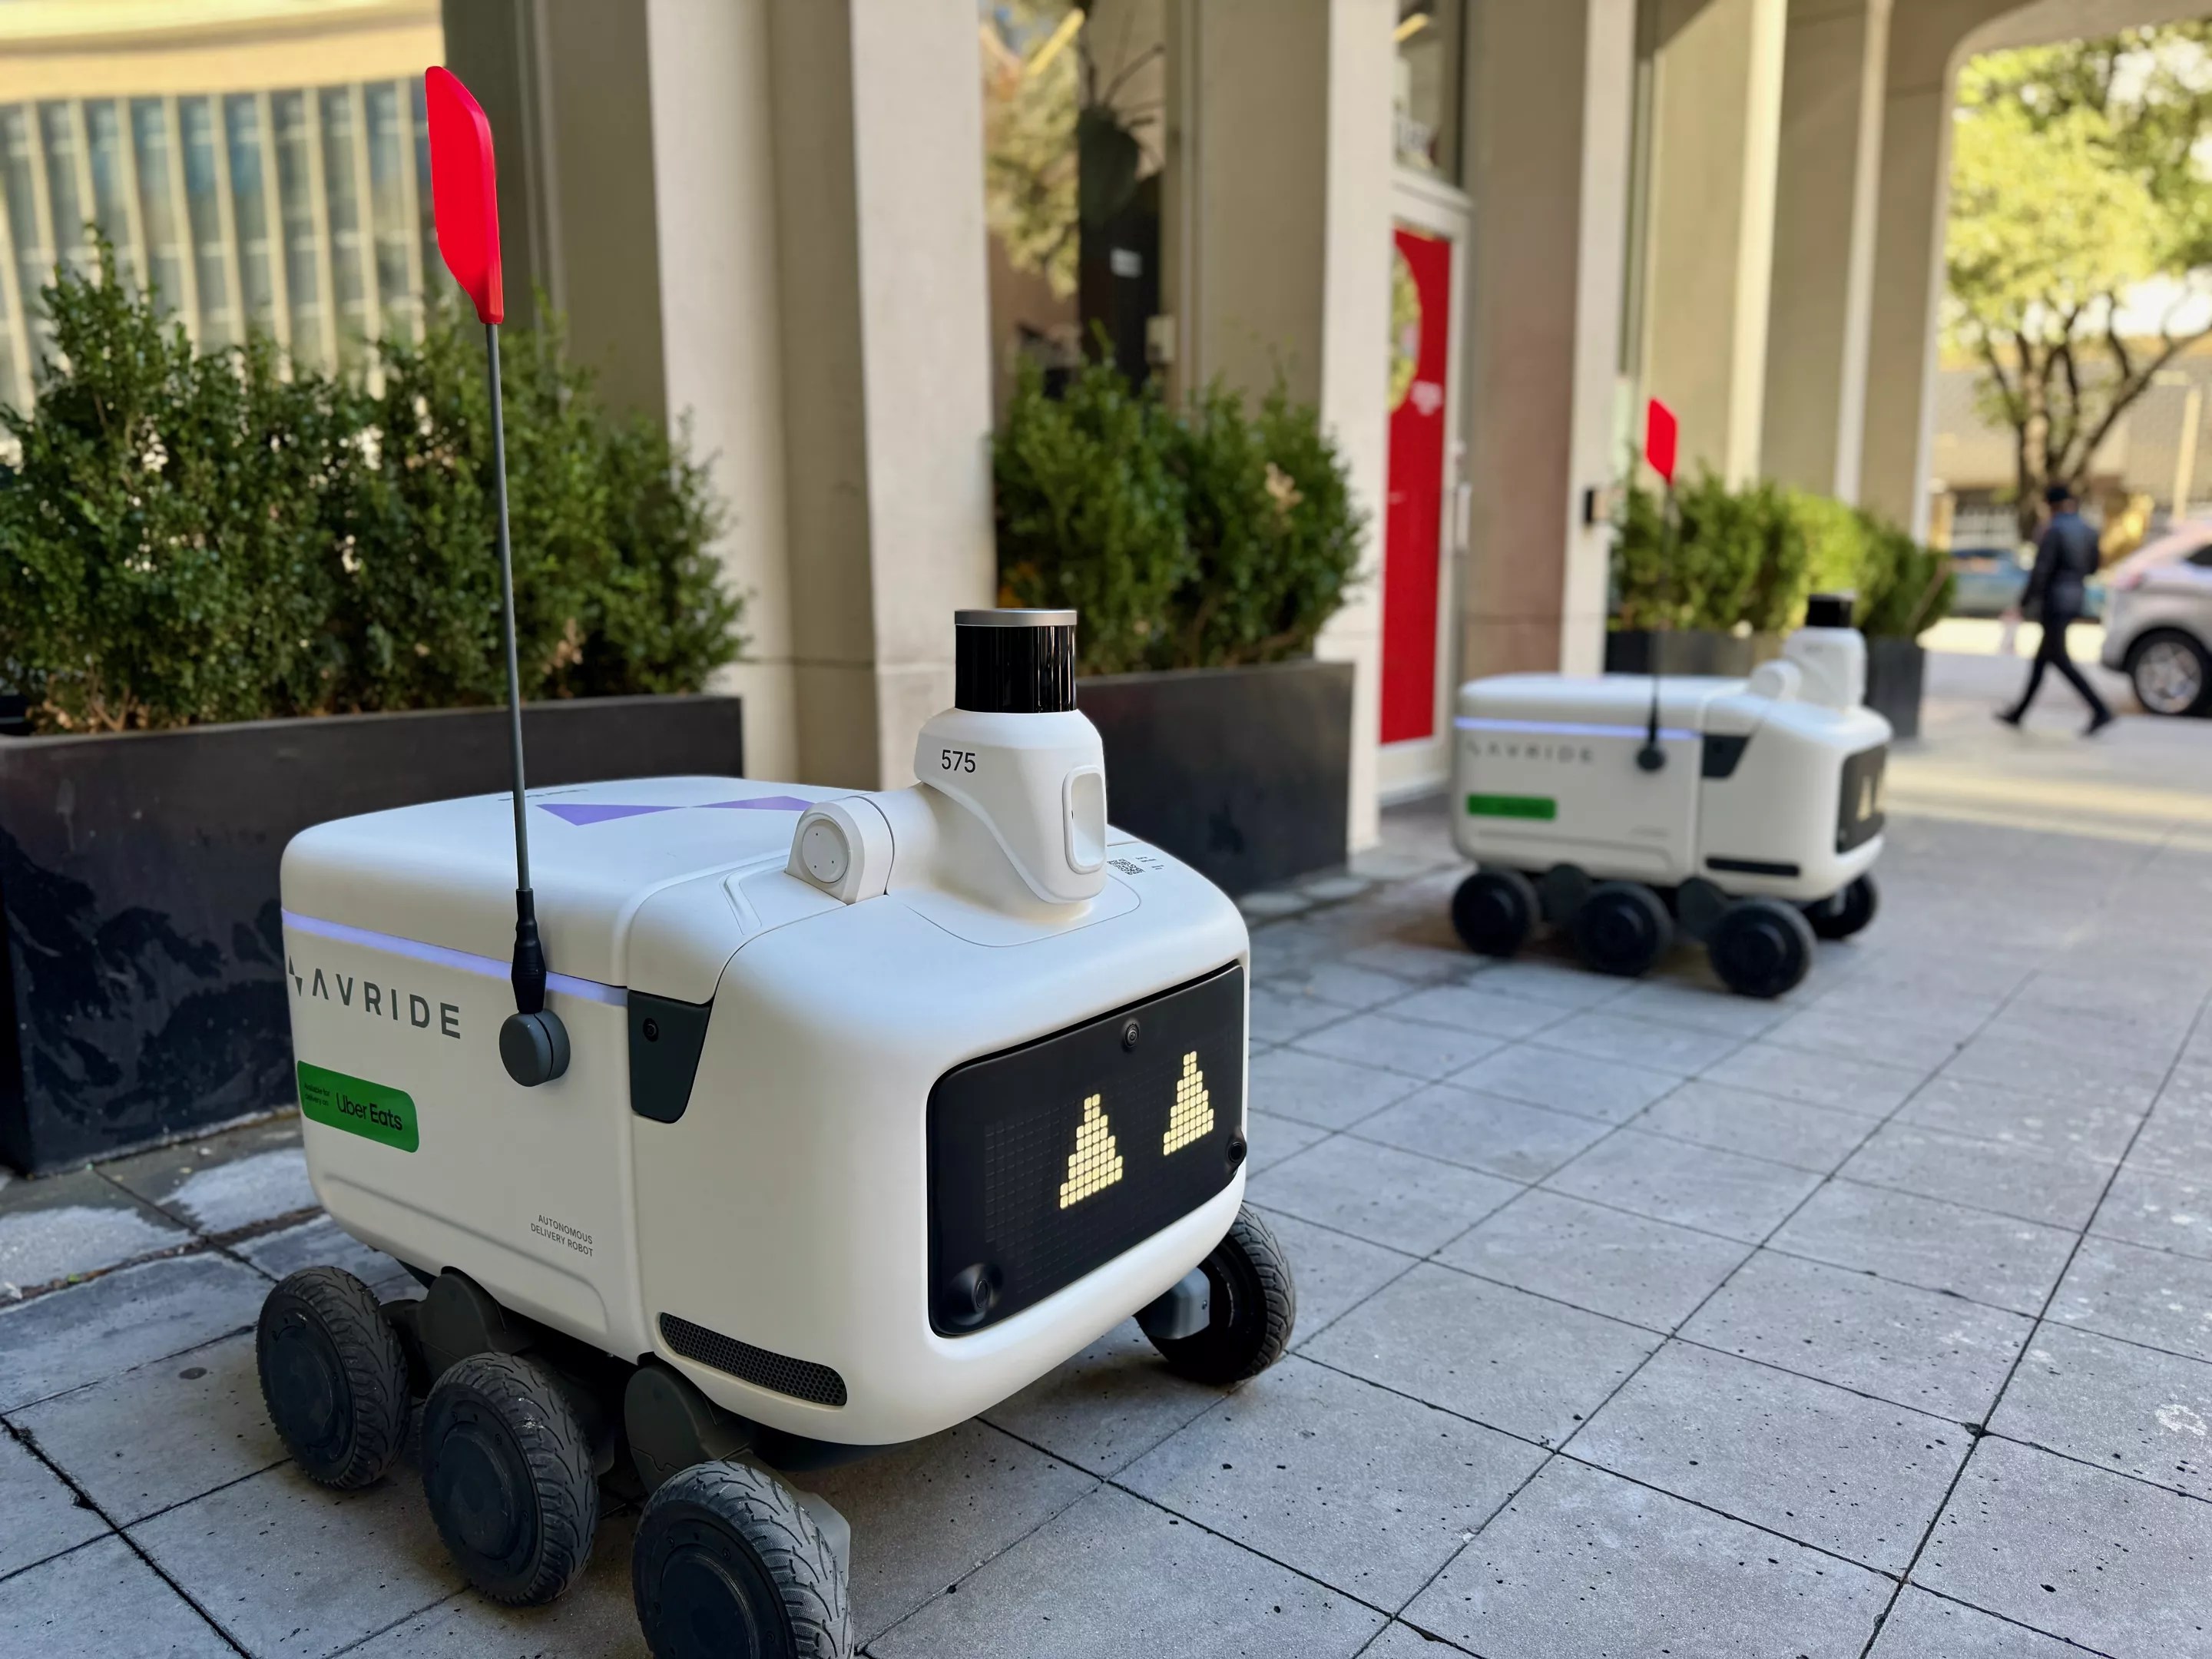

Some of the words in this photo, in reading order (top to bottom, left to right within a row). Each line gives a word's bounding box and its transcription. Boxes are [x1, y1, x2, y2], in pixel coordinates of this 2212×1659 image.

[942, 749, 976, 773] 575
[312, 968, 461, 1039] AVRIDE
[336, 1092, 367, 1119] Uber
[369, 1103, 403, 1131] Eats
[531, 1223, 565, 1245] DELIVERY
[568, 1238, 594, 1257] ROBOT
[538, 1214, 593, 1244] AUTONOMOUS
